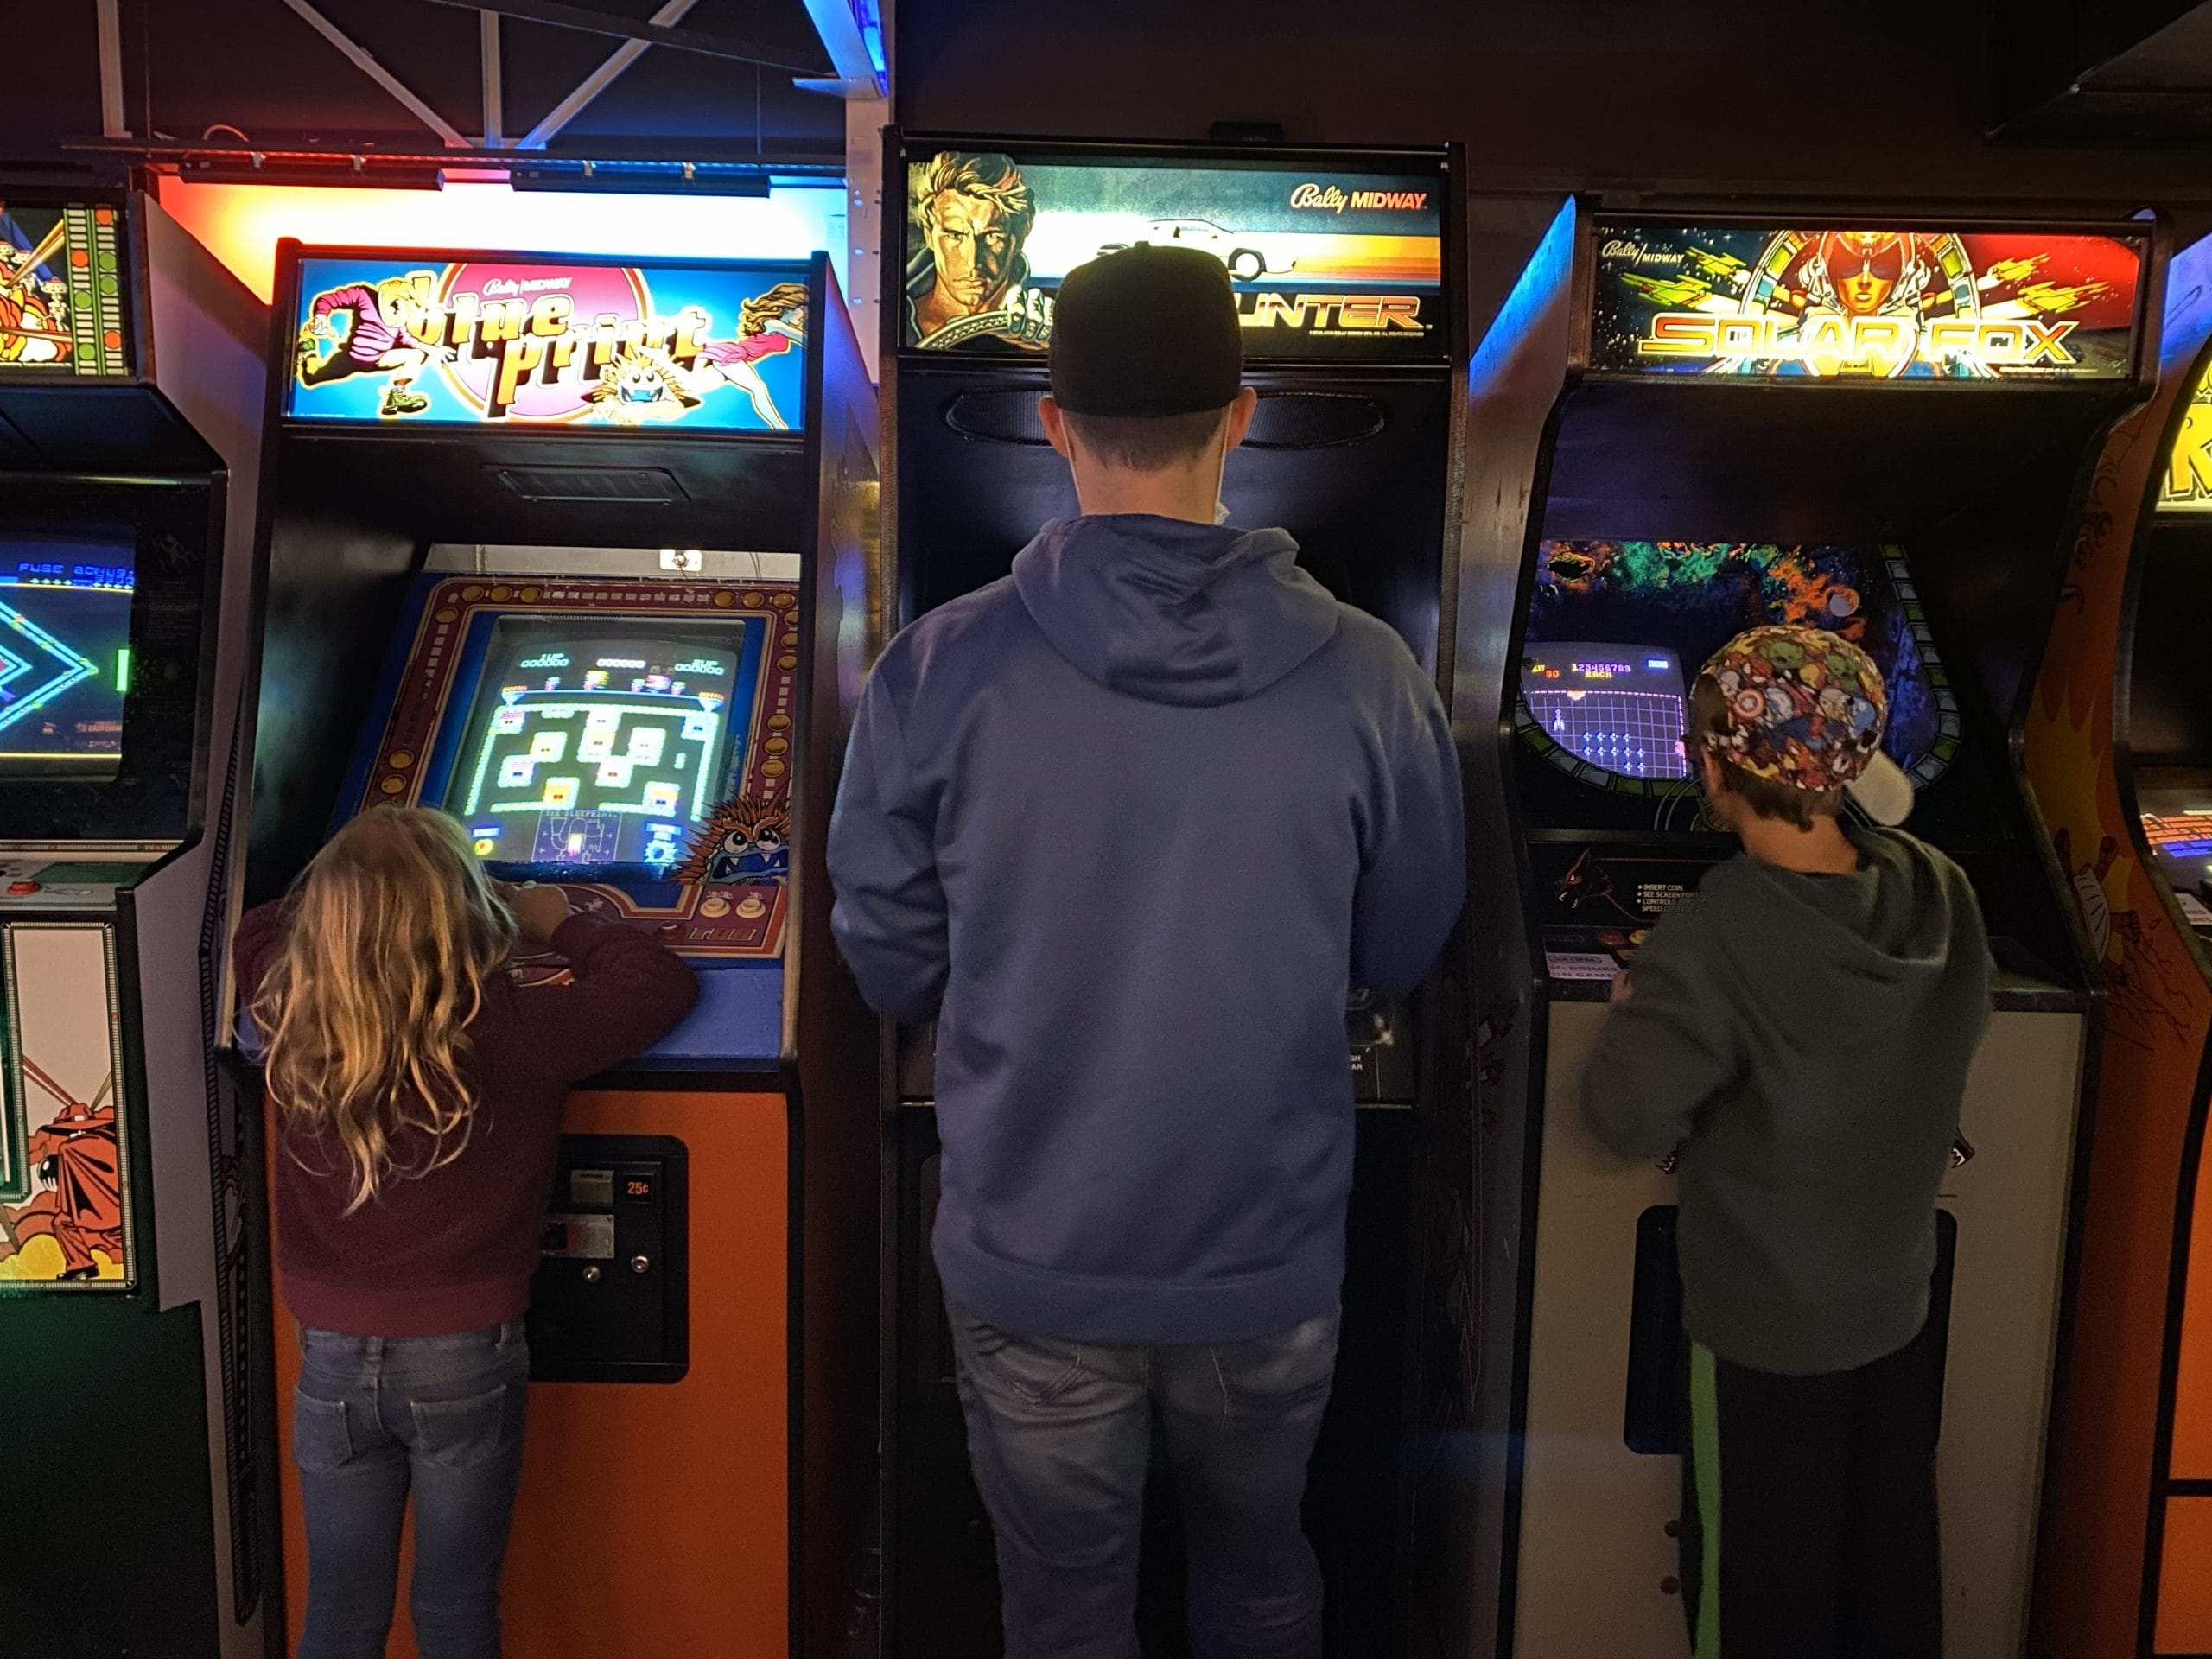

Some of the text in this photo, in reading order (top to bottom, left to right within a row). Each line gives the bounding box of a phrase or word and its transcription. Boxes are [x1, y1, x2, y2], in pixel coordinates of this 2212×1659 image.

[1290, 182, 1427, 214] Bally MIDWAY
[1642, 252, 1685, 264] MIDWAY
[1234, 292, 1425, 328] UNTER
[1638, 312, 2079, 364] SOLAR FOX
[18, 563, 64, 574] FUSE
[627, 1181, 649, 1195] 25¢
